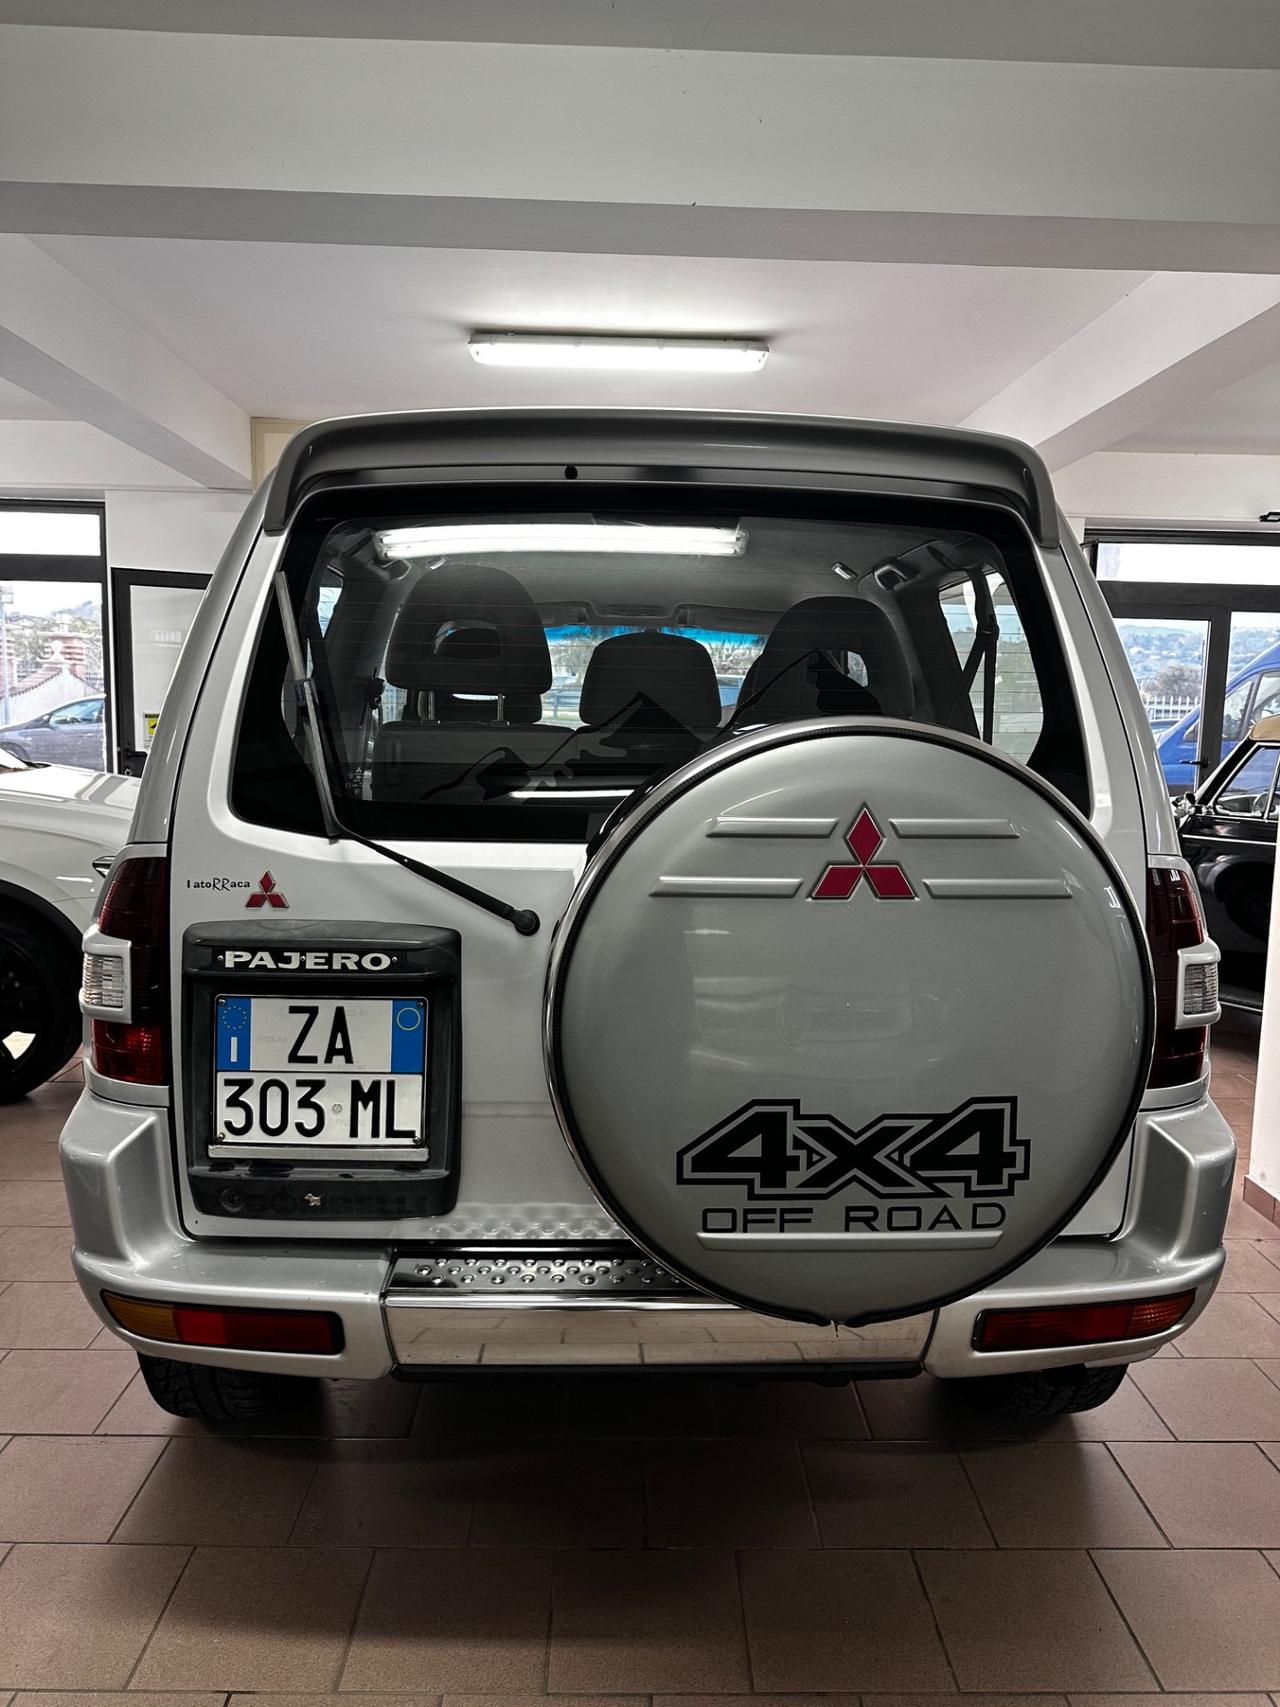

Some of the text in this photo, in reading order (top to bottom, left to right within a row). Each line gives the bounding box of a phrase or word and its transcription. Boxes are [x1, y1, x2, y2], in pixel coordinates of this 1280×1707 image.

[224, 950, 391, 970] PAJERO
[287, 1005, 355, 1065] ZA
[223, 1078, 417, 1139] 303 ML
[702, 1202, 1006, 1234] OFF ROAD
